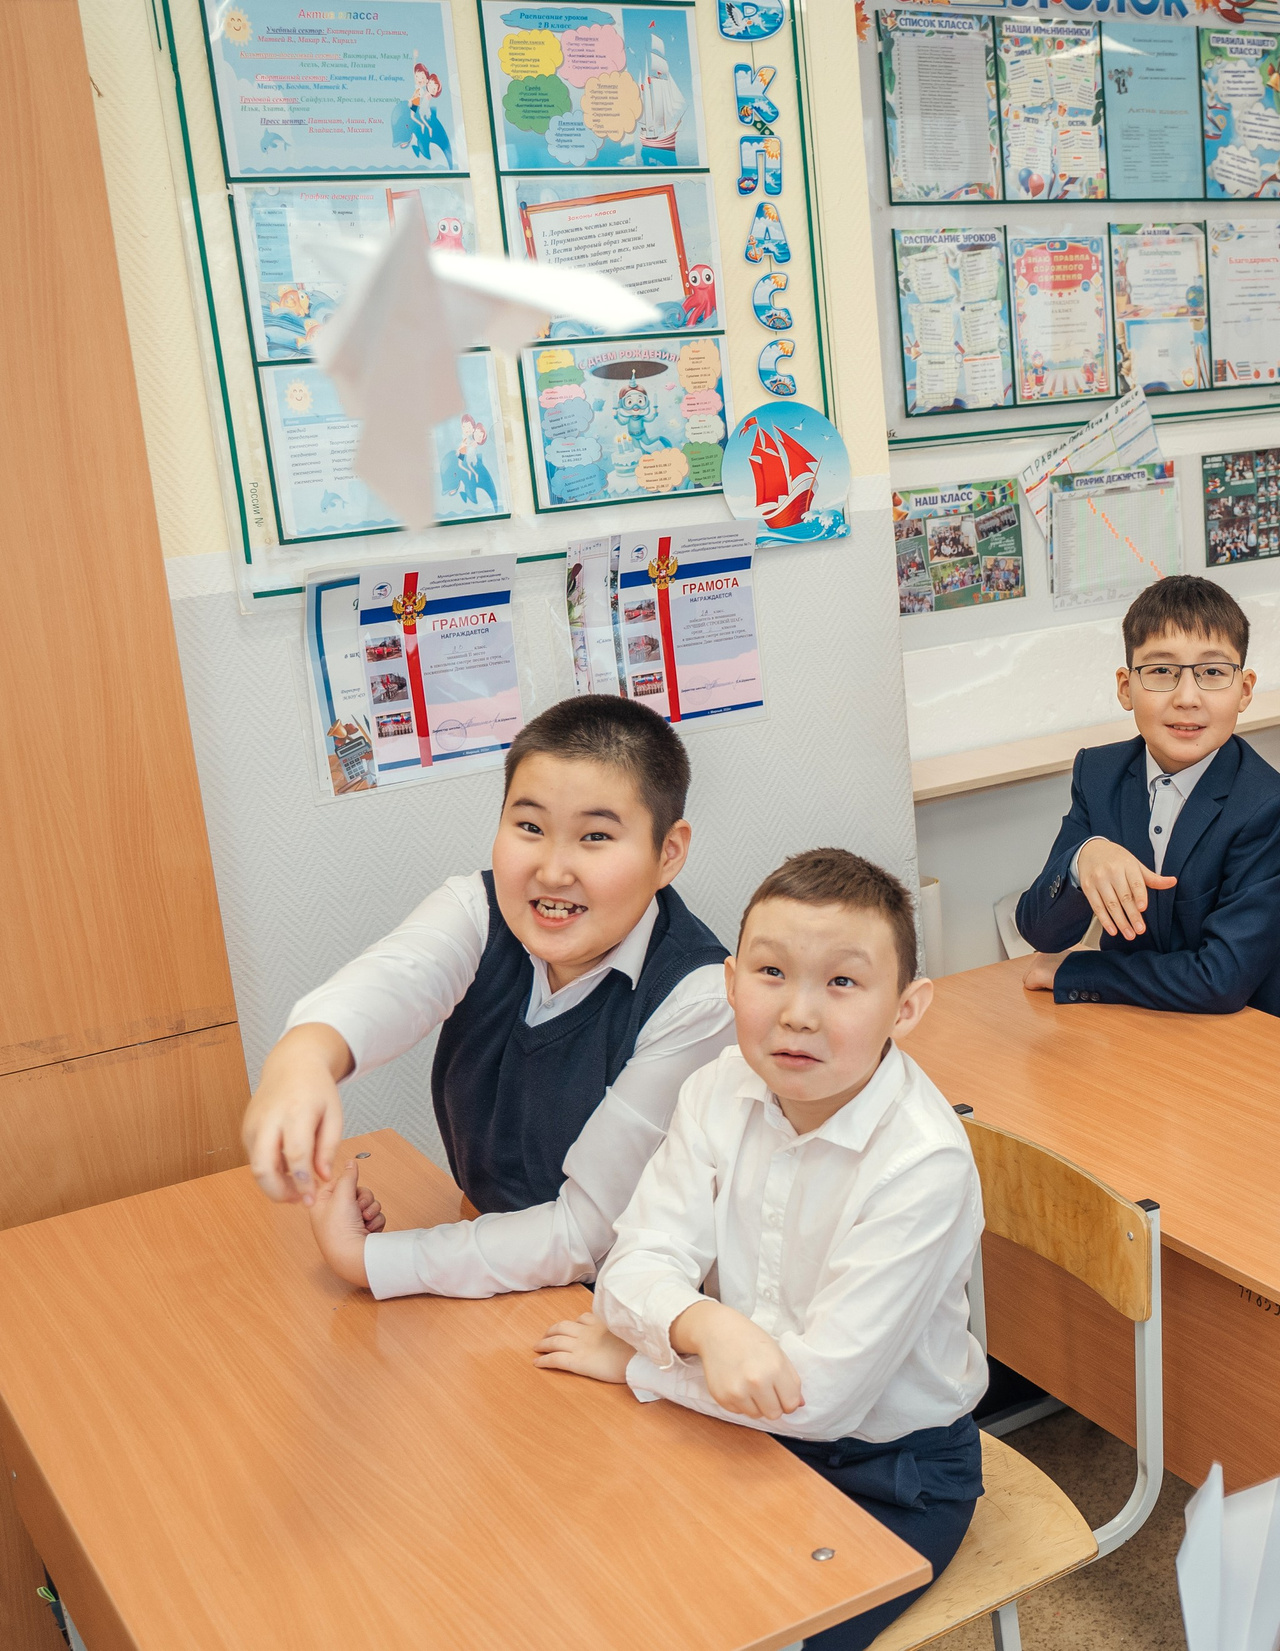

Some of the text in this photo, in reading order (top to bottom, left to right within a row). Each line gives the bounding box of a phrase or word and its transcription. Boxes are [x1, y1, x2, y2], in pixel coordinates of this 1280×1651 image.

[298, 9, 334, 20] Актив
[520, 12, 588, 23] Расписание уроков
[899, 17, 974, 31] СПИСОК КЛАССА
[1005, 24, 1091, 37] НАШИ ИМЕНИННИКИ
[1212, 36, 1276, 48] ПРАВИЛА НАШЕГО
[1229, 47, 1260, 56] КЛАССА!
[568, 209, 617, 221] Законы класса
[549, 226, 583, 237] Дорожить
[609, 218, 631, 227] класса!
[733, 63, 795, 398] КЛАСС
[904, 233, 997, 245] РАСПИСАНИЕ УРОКОВ
[1228, 257, 1280, 265] Благодарность
[1075, 470, 1146, 486] ГРАФИК ДЕЖУРСТВ
[249, 482, 260, 515] России
[915, 492, 973, 507] НАШ КЛАСС
[682, 577, 739, 595] ГРАМОТА
[690, 592, 733, 603] НАГРАЖДАЕТСЯ
[432, 612, 497, 631] ГРАМОТА
[441, 627, 490, 639] НАГРАЖДАЕТСЯ
